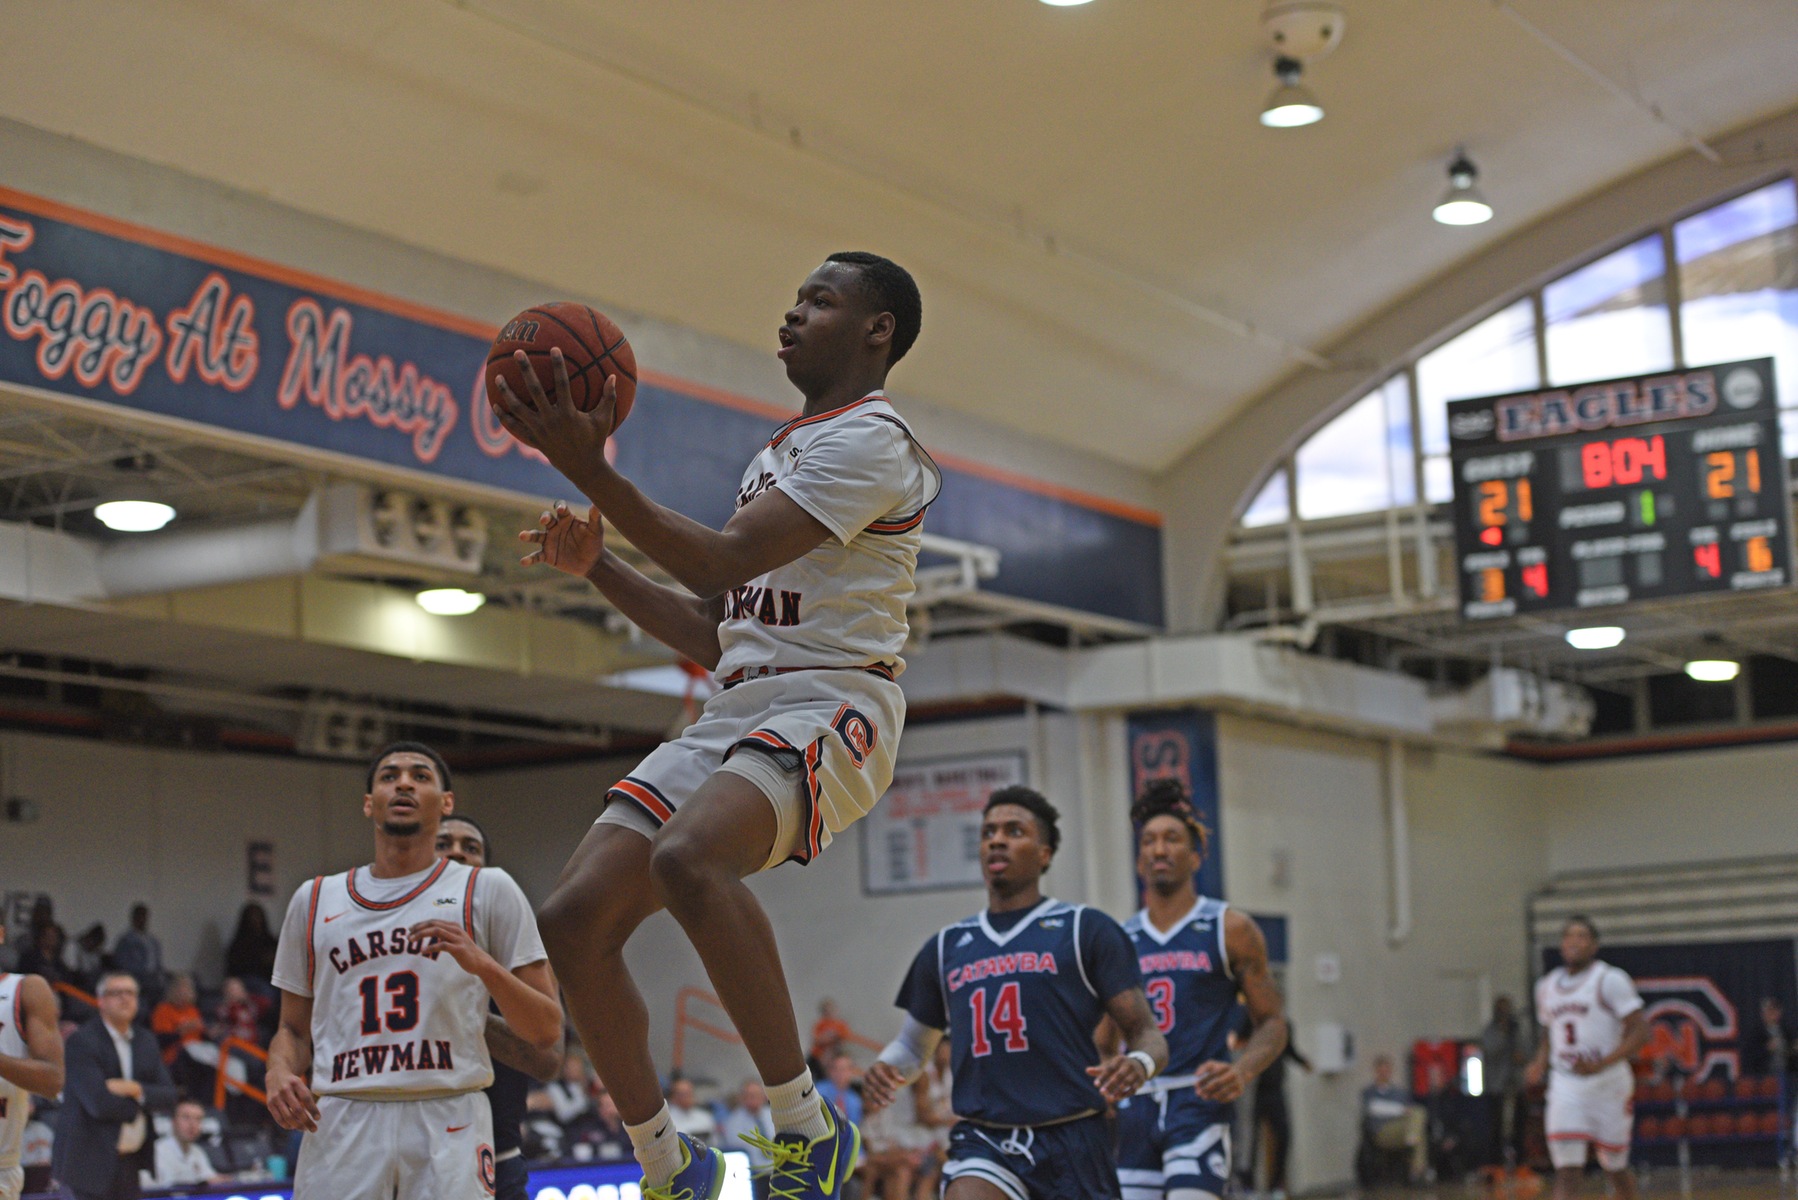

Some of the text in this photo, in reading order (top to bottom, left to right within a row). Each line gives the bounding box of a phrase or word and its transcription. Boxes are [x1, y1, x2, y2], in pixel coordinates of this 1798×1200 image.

[167, 272, 260, 391] At
[278, 297, 459, 463] Mossy
[1498, 372, 1717, 440] EAGLES
[1479, 476, 1533, 527] 21
[1706, 448, 1761, 499] 21
[946, 951, 1058, 992] CATAWBA
[359, 969, 420, 1036] 13
[969, 981, 1029, 1058] 14
[331, 1039, 454, 1083] NEWMAN
